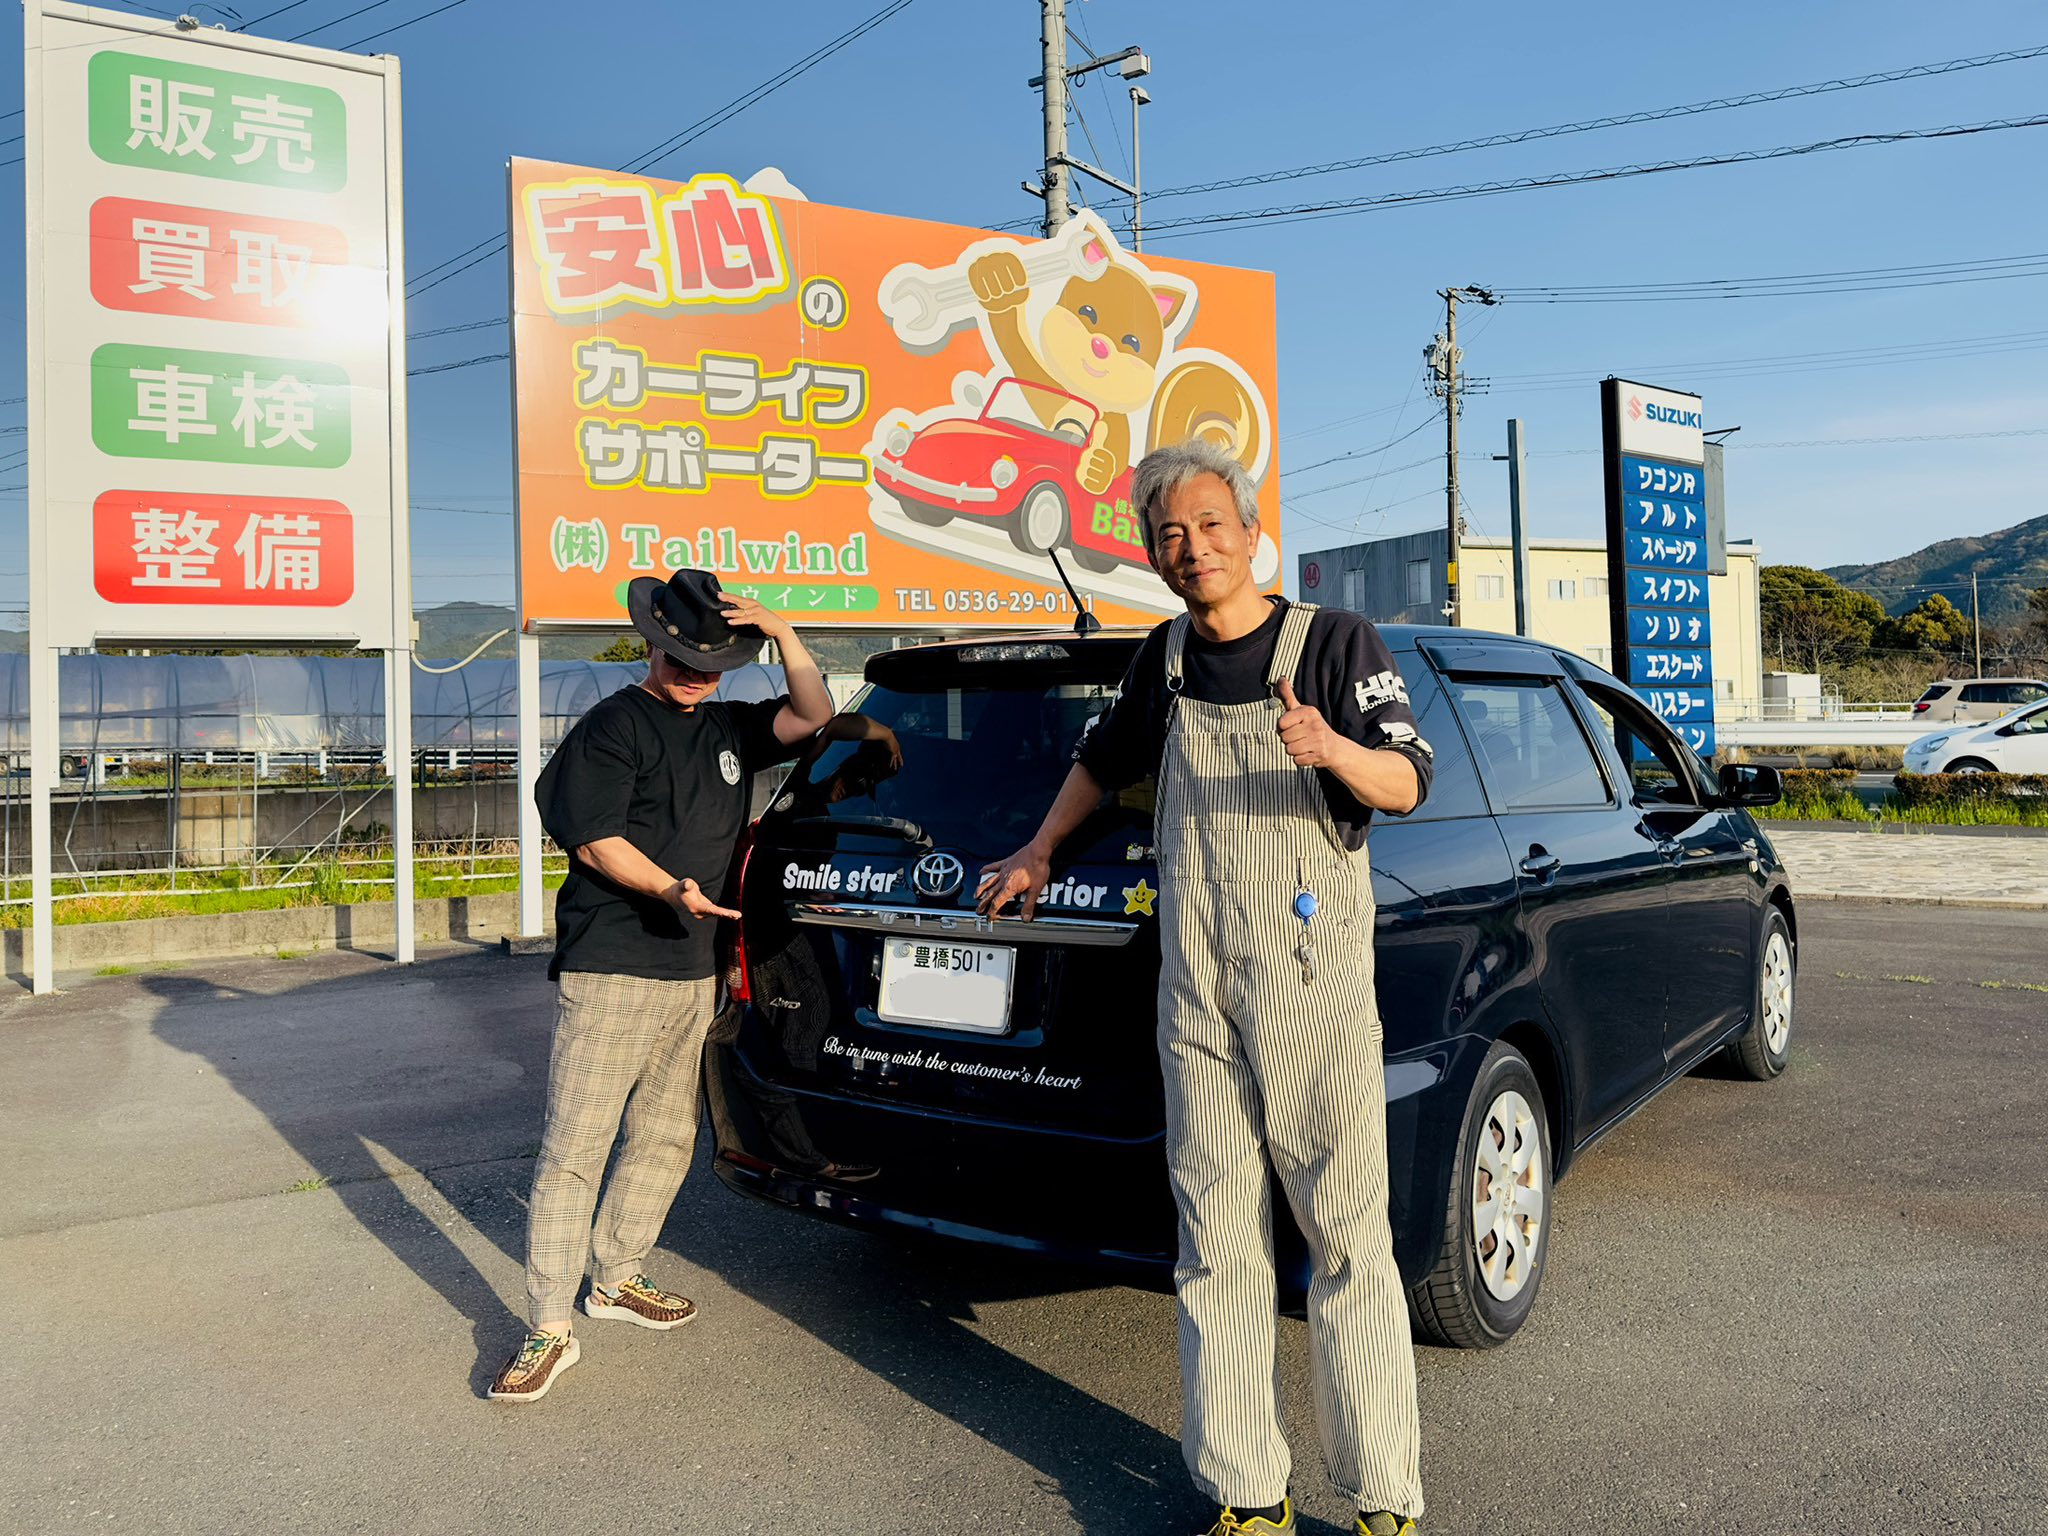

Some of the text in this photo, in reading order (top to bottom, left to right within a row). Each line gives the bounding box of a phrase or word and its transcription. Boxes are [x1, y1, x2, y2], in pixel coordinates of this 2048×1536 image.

[125, 74, 316, 174] 販売
[127, 217, 314, 308] 買取
[534, 186, 778, 301] 安心
[802, 280, 846, 325] の
[577, 341, 865, 423] カーライフ
[127, 363, 319, 452] 車検
[1646, 402, 1702, 430] SUZUKI
[580, 421, 867, 494] サポーター
[1638, 465, 1696, 495] ワゴンR
[1091, 501, 1144, 548] Bas
[1639, 501, 1697, 530] アルト
[130, 508, 322, 591] 整備
[623, 525, 867, 574] Tailwind
[895, 588, 937, 612] TEL
[1643, 576, 1700, 603] スイフト
[1645, 615, 1702, 642] ソリオ
[1646, 653, 1703, 680] エスクード
[1359, 694, 1396, 714] HONDA
[1649, 691, 1705, 717] ハスラー
[783, 862, 1108, 909] Smile star erior
[879, 911, 994, 934] WISH
[823, 1036, 1082, 1090] Be in tune with the customer's heart
